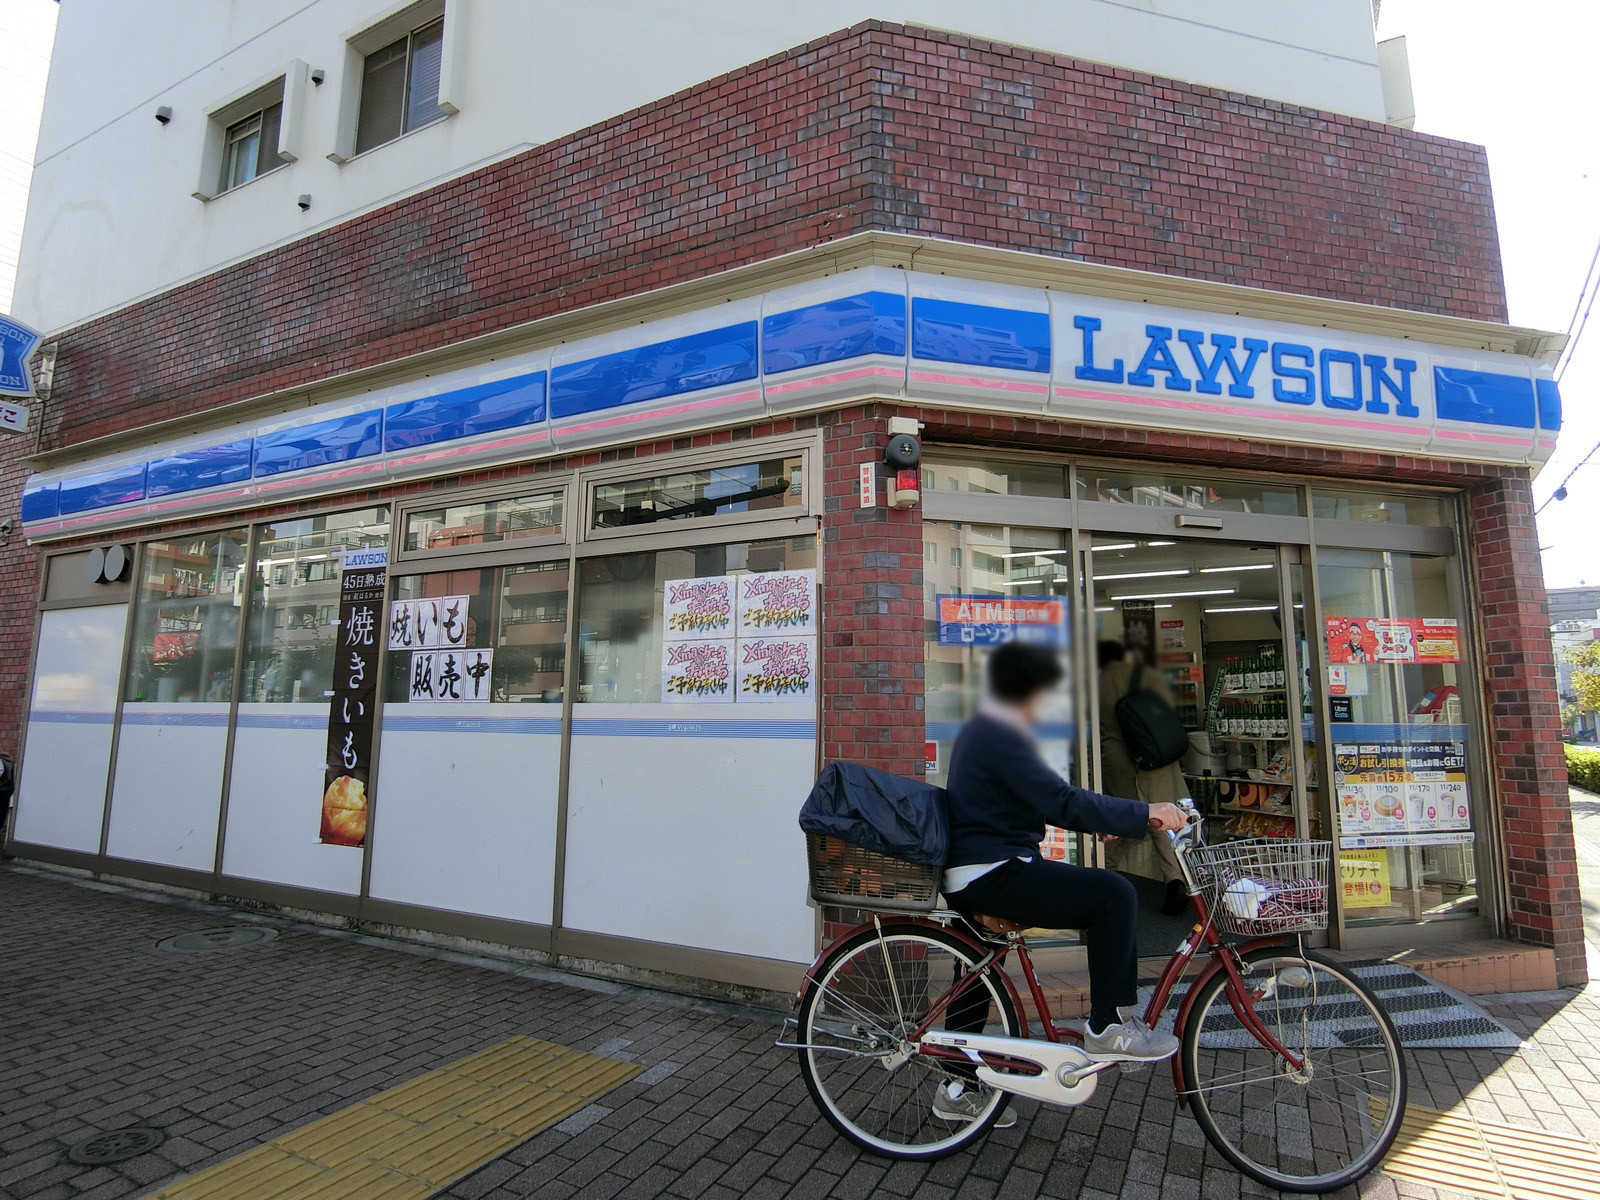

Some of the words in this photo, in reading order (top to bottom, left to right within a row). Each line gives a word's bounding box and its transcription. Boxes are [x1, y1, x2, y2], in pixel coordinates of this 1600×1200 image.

[1074, 315, 1419, 418] LAWSON
[345, 552, 388, 566] LAWSON
[343, 572, 386, 589] 45日熟成
[391, 600, 465, 646] 焼いも
[342, 606, 376, 769] 焼きいも
[412, 652, 490, 699] 販売中
[1344, 882, 1368, 896] 登場!
[1112, 1035, 1132, 1051] N
